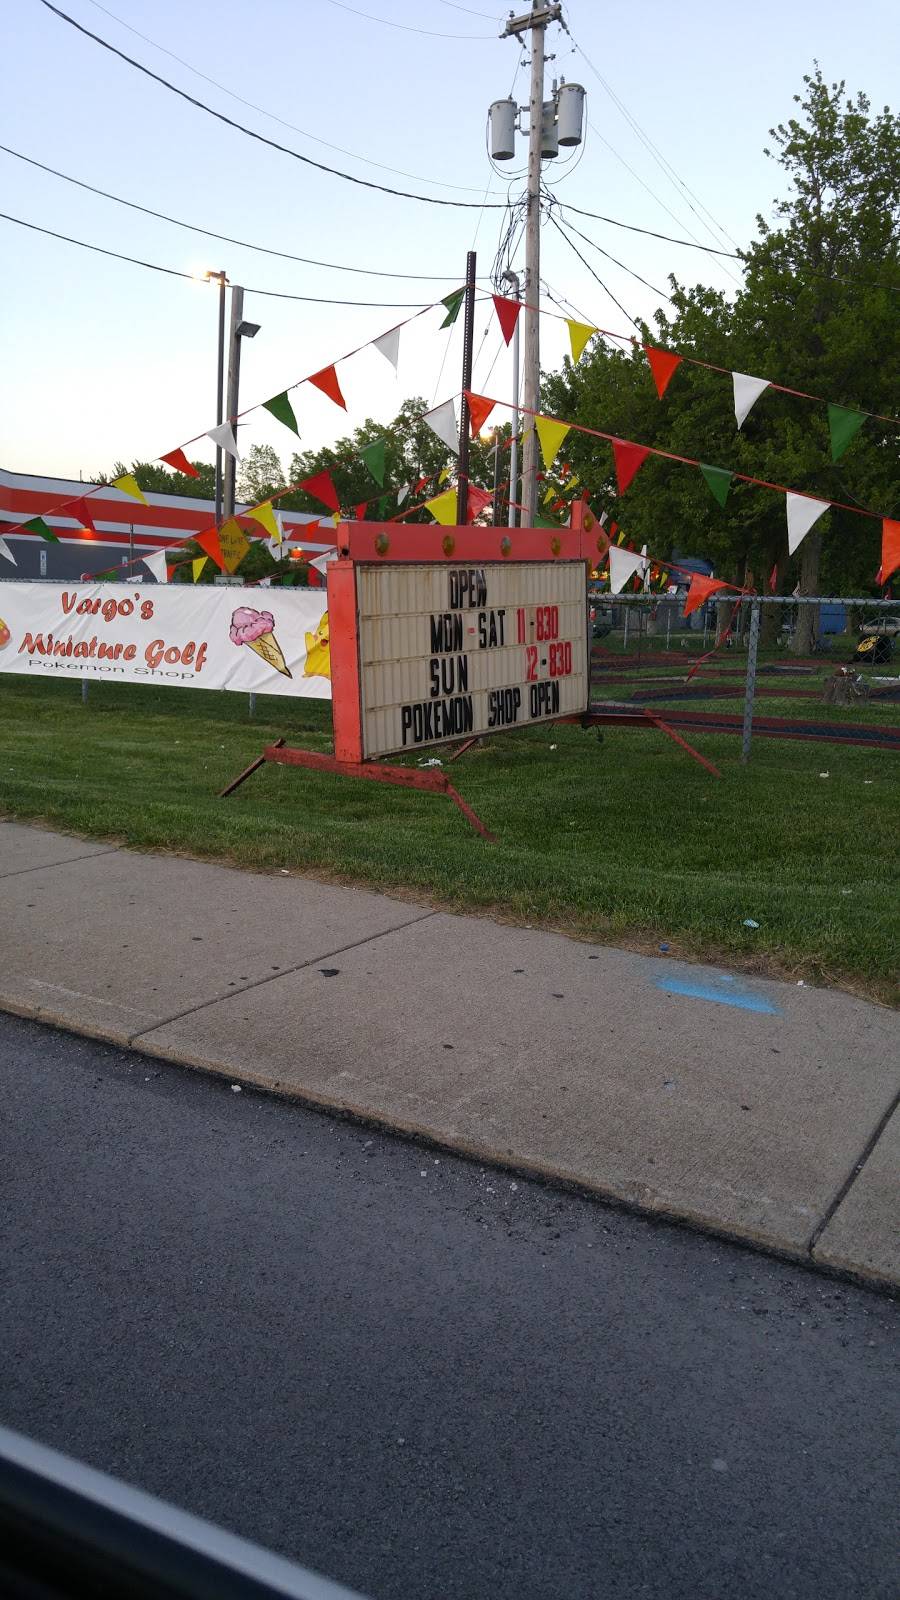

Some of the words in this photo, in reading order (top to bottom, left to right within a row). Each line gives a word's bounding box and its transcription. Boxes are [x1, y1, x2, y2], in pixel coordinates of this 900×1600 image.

[61, 592, 154, 622] Vargo's
[450, 569, 487, 609] OPEN
[18, 632, 137, 661] Miniature
[144, 639, 207, 672] Golf
[28, 659, 125, 674] Pokemon
[133, 667, 195, 680] Shop
[429, 655, 468, 697] SUN
[402, 695, 473, 745] POKEMON
[488, 687, 521, 727] SHOP
[530, 680, 560, 718] OPEN
